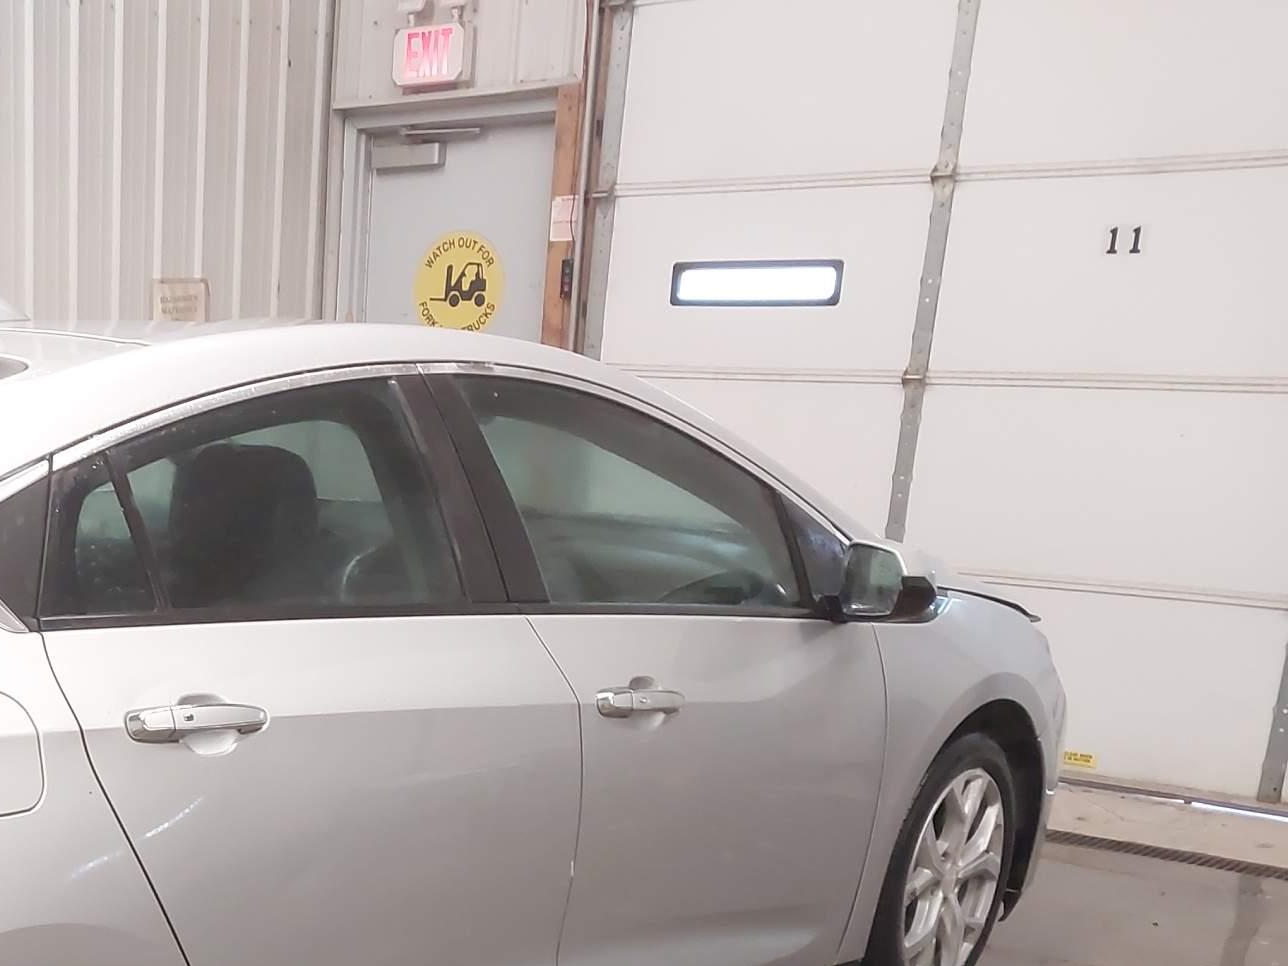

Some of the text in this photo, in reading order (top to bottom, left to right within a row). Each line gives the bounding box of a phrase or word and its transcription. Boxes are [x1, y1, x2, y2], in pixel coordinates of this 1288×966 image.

[406, 27, 453, 77] EXIT
[425, 236, 495, 269] WATCH OUT FOR
[1105, 225, 1142, 254] 11
